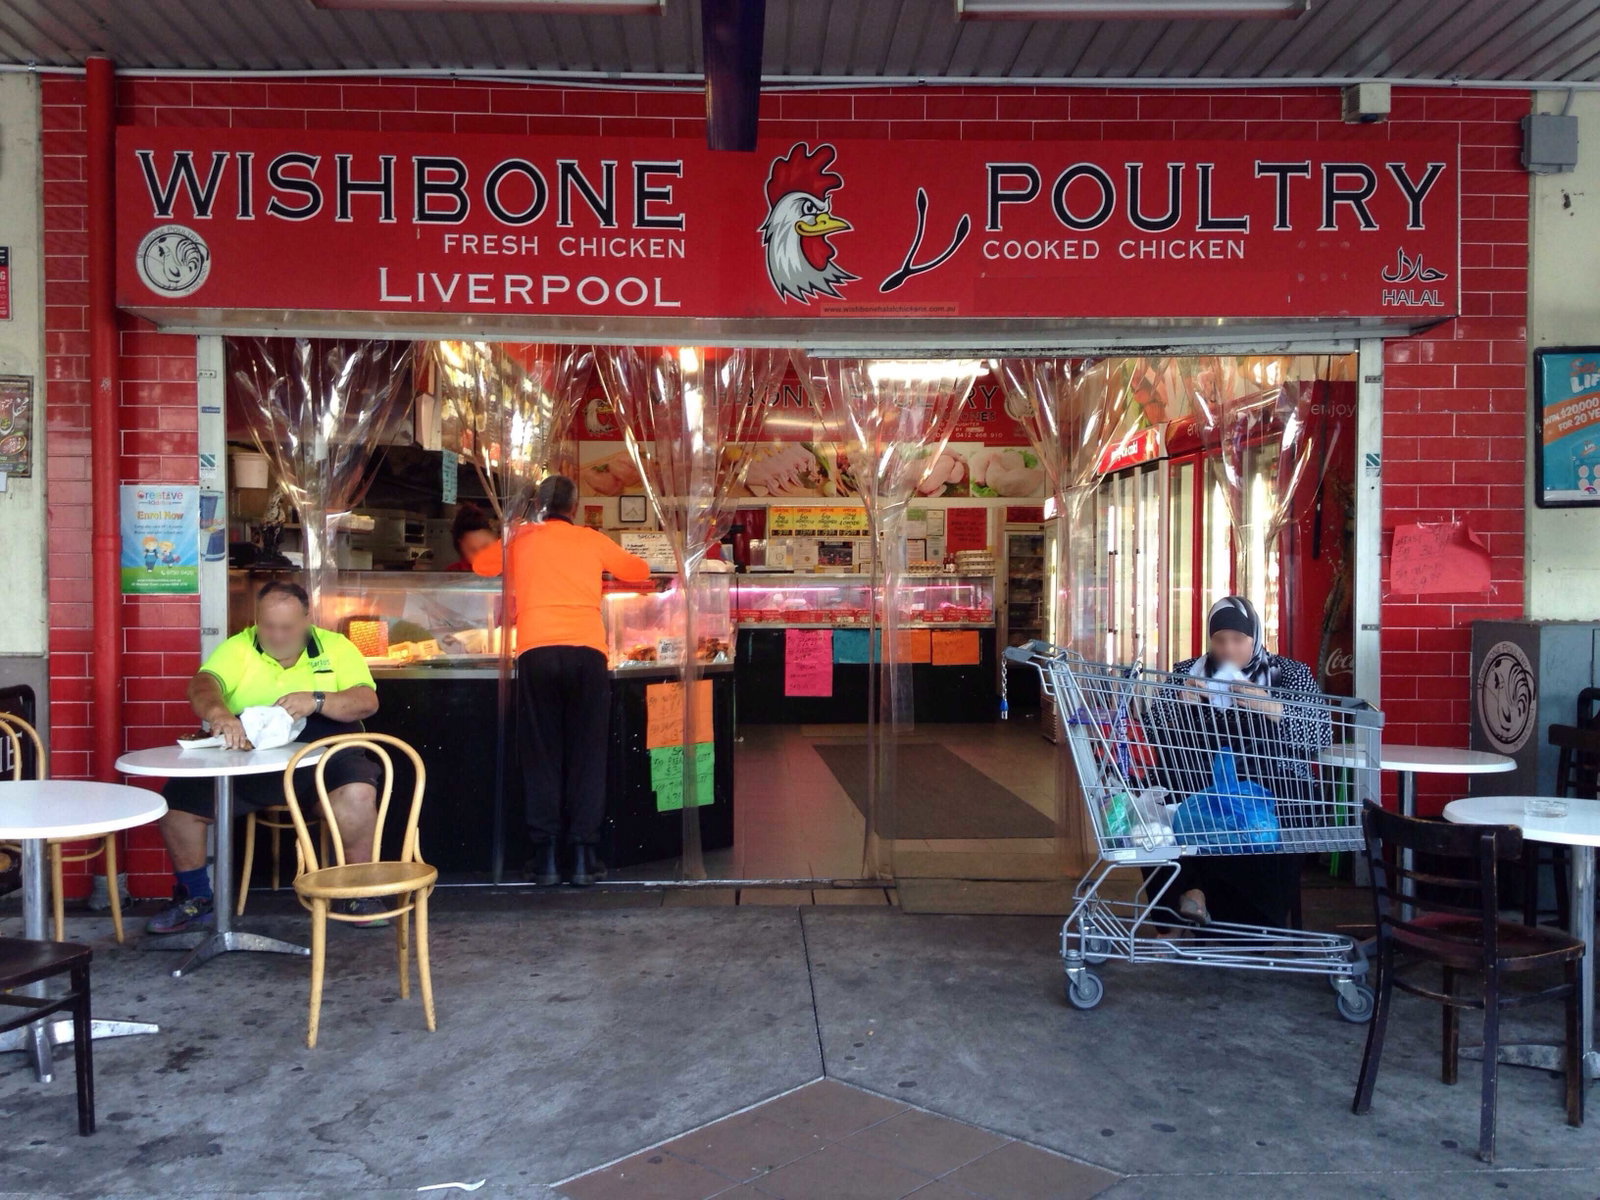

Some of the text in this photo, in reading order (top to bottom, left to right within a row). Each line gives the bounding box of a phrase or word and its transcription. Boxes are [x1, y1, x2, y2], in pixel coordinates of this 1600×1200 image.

[135, 149, 1447, 234] WISHBONE POULTRY
[443, 233, 686, 259] FRESH CHICKEN
[983, 239, 1245, 260] COOKED CHICKEN
[1381, 246, 1449, 283] حلال
[378, 267, 682, 307] LIVERPOOL
[1382, 289, 1445, 306] HALAL
[1558, 419, 1574, 432] FOR
[1574, 413, 1588, 426] 20
[136, 511, 184, 520] Enrol Now
[1325, 647, 1354, 677] Coc
